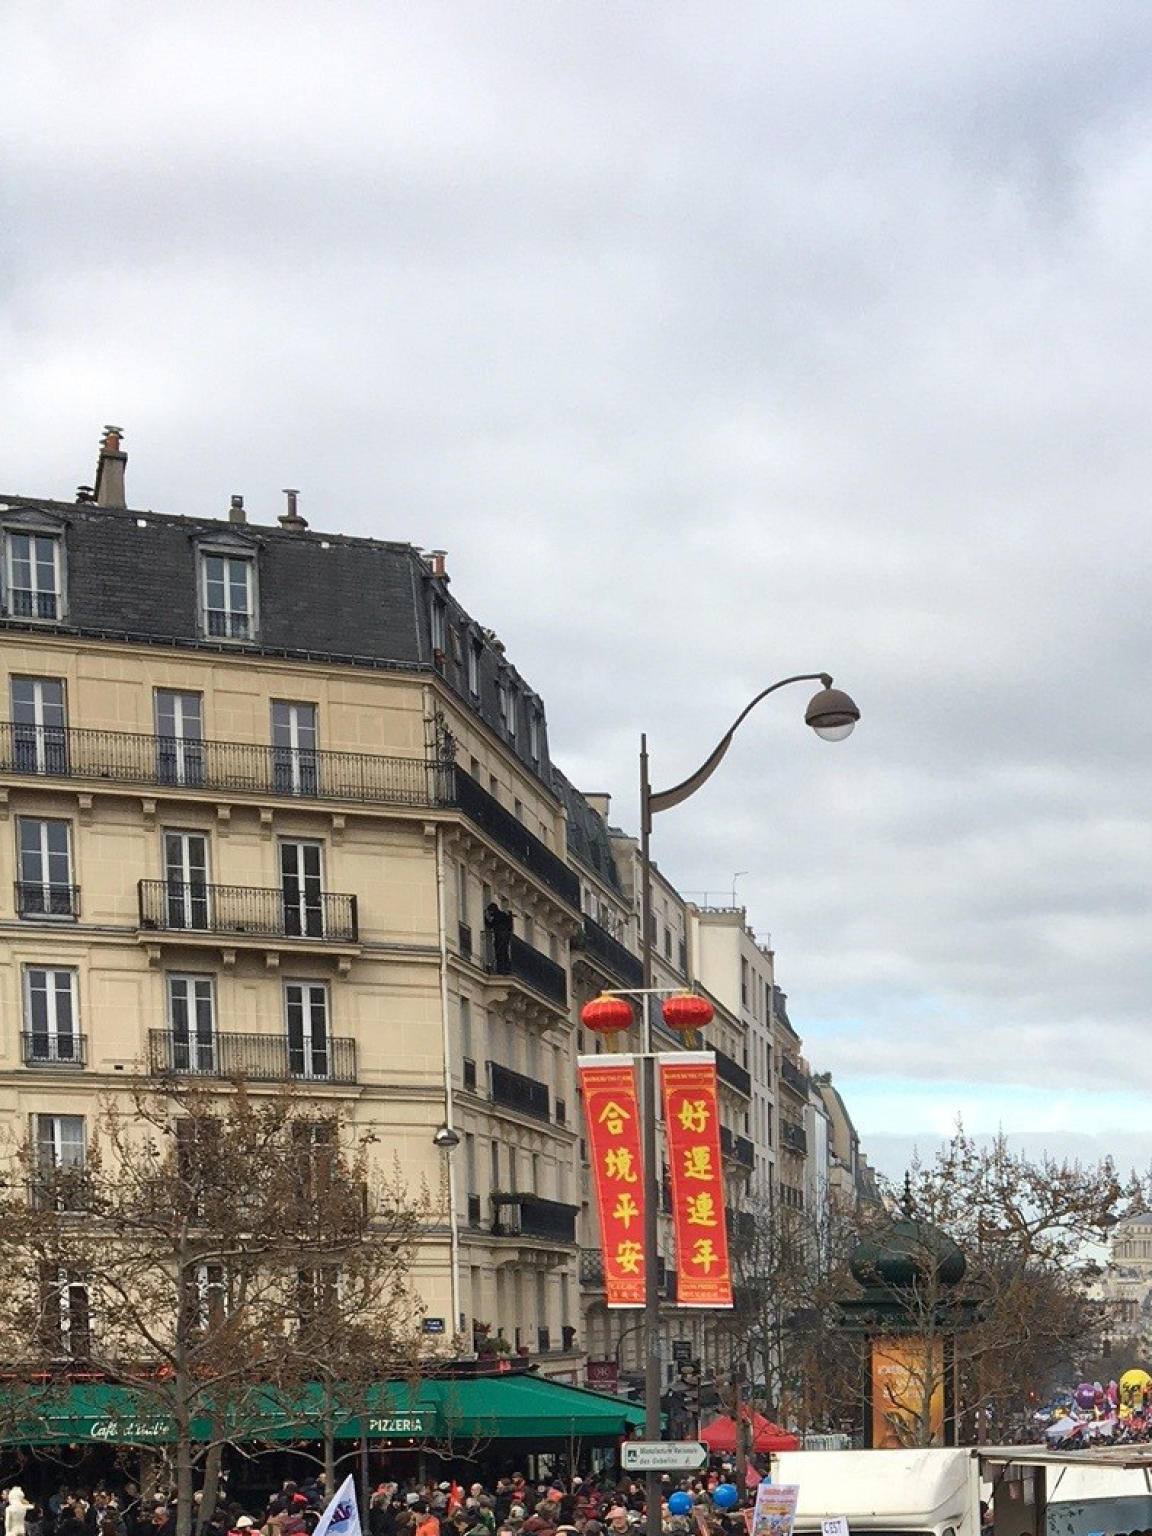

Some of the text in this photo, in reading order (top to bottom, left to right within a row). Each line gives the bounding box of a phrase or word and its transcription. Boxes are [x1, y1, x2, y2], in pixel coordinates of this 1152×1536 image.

[678, 1098, 718, 1274] 好運連年
[369, 1418, 423, 1432] PIZZERIA
